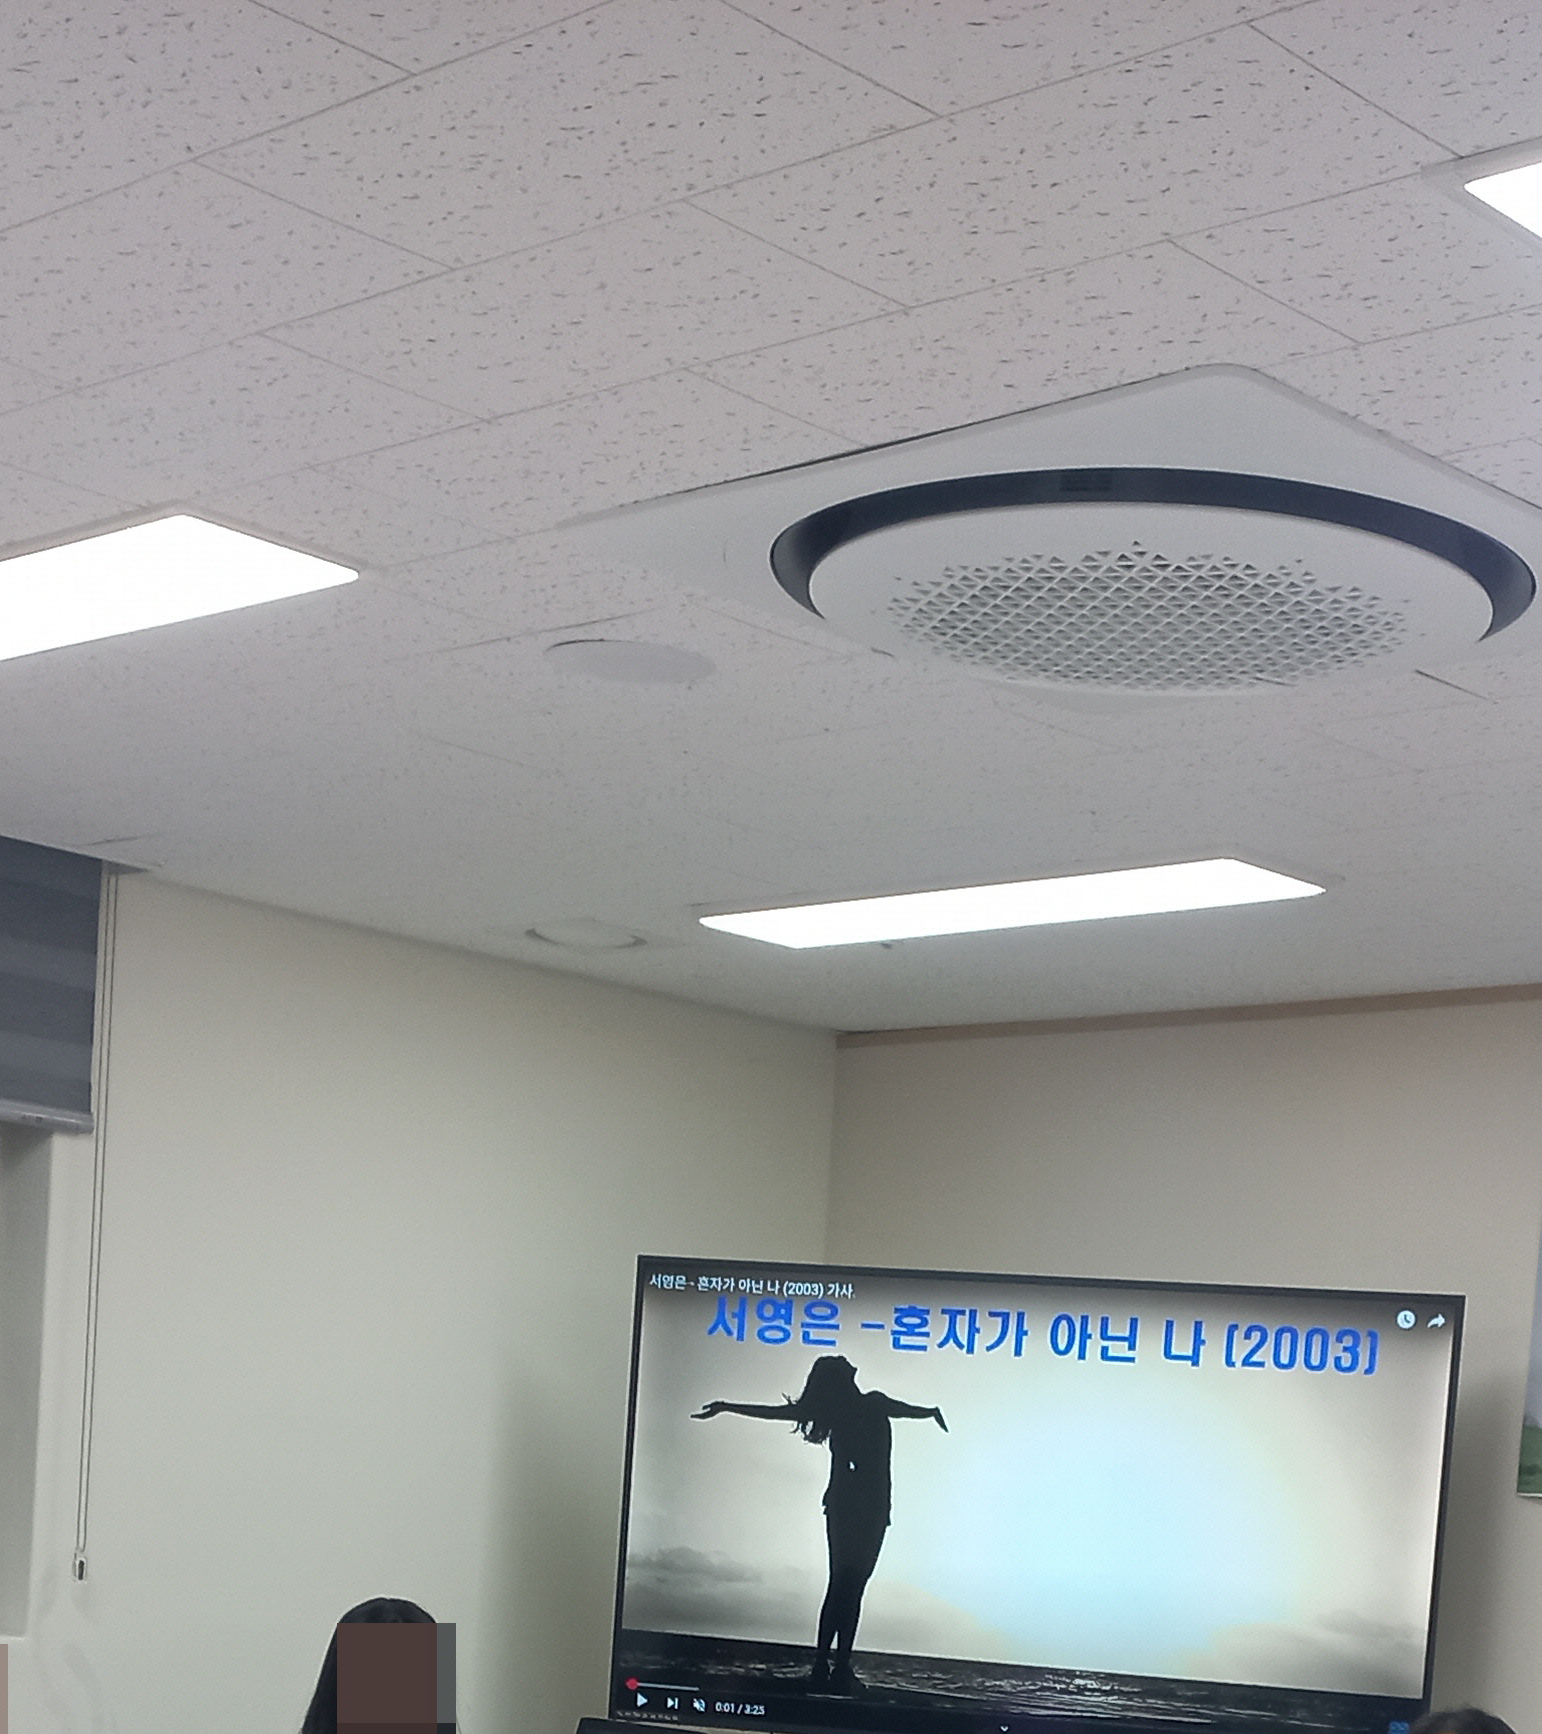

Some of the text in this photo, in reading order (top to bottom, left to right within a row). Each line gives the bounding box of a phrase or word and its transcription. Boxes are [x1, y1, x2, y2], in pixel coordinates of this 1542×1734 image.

[739, 1278, 763, 1294] 아닌
[767, 1279, 780, 1295] 나
[783, 1280, 824, 1299] (2003)
[707, 1296, 841, 1348] 서영은
[1049, 1313, 1139, 1364] 아닌
[1163, 1319, 1207, 1368] 나
